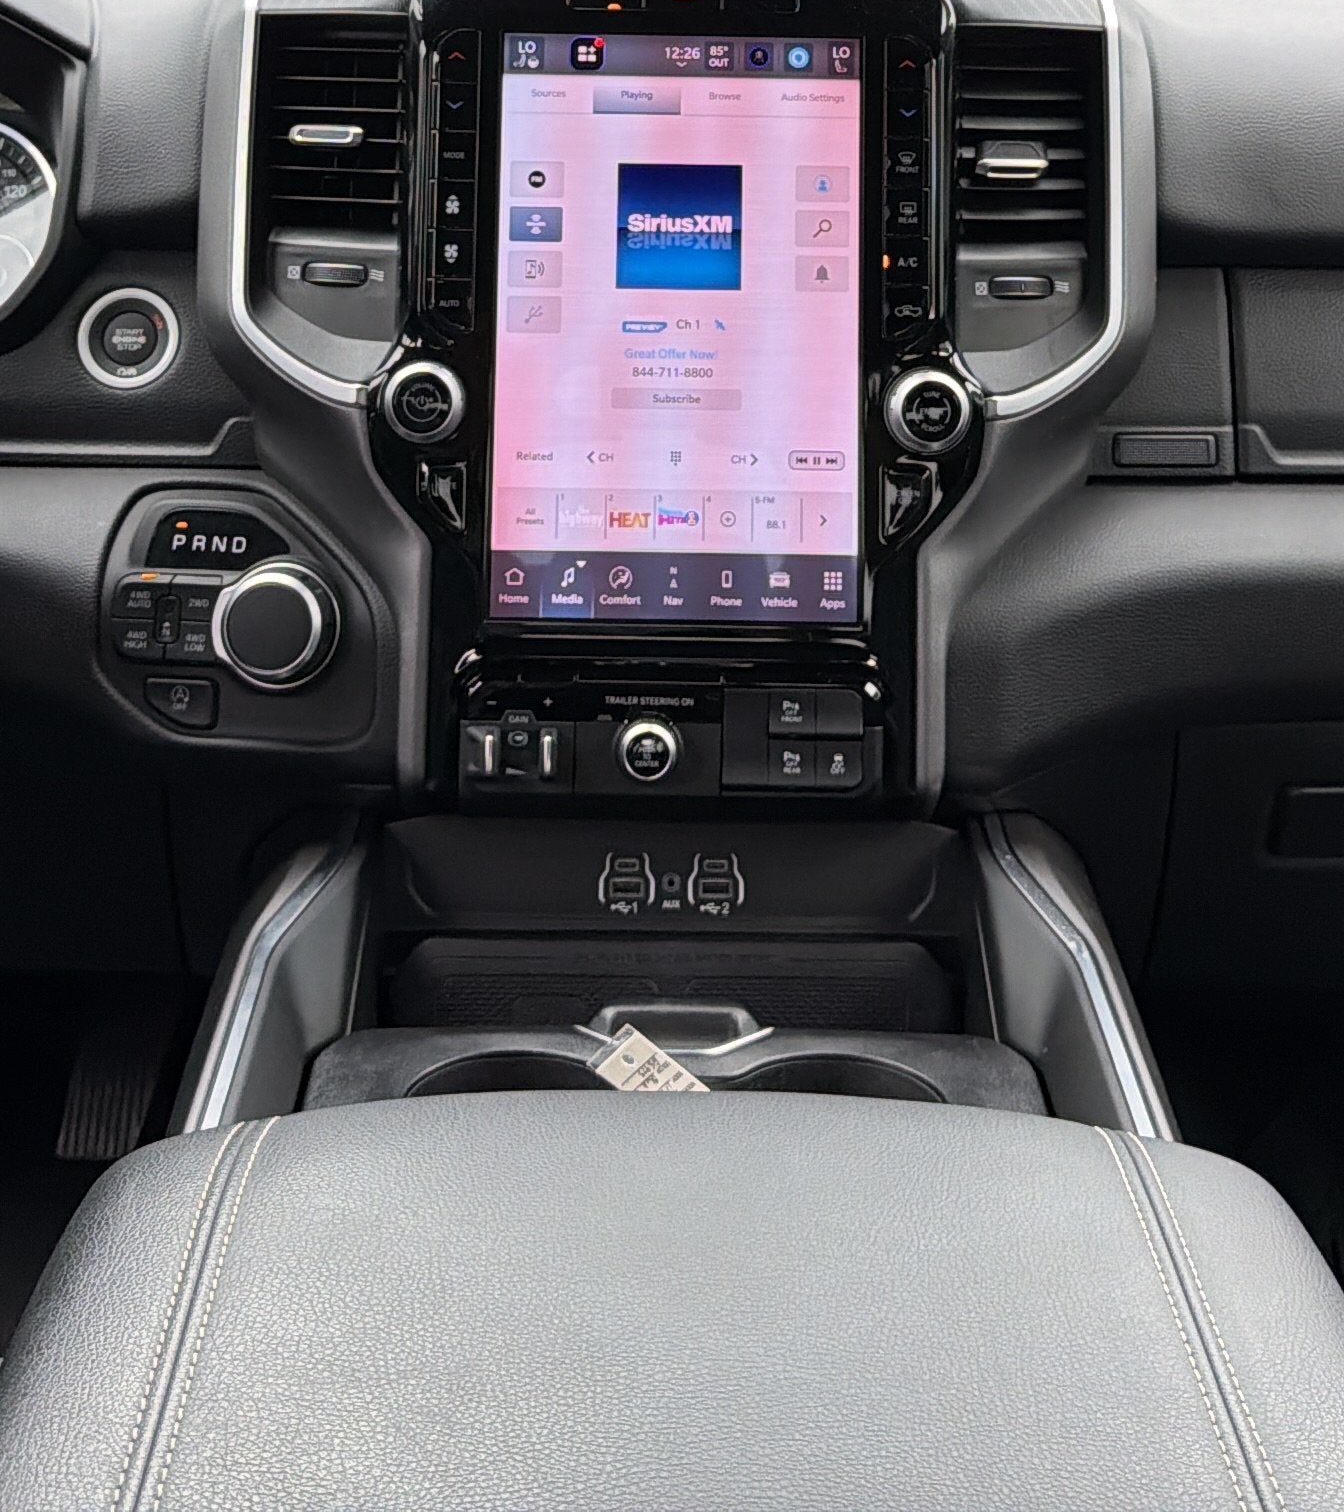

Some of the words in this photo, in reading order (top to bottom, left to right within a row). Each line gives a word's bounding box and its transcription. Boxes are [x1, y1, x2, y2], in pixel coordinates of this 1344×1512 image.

[517, 39, 537, 54] LO
[831, 45, 851, 59] LO
[664, 45, 701, 60] 12:26
[708, 58, 730, 68] OUT
[531, 88, 567, 98] Sources
[620, 90, 654, 102] Playing
[709, 91, 742, 101] Browse
[781, 93, 808, 102] Audio
[809, 93, 846, 104] Settings
[442, 151, 465, 159] MODE
[896, 165, 920, 174] FRONT
[2, 184, 28, 198] 120
[626, 213, 733, 233] SiriusXM
[897, 256, 919, 268] A/C
[438, 299, 461, 308] AUTO
[675, 319, 692, 330] Ch
[624, 347, 656, 359] Great
[658, 347, 687, 359] Offer
[632, 366, 714, 378] 844-711-8800
[652, 393, 702, 404] Subscribe
[516, 451, 554, 462] Related
[598, 453, 614, 463] CH
[730, 454, 747, 464] CH
[516, 517, 545, 526] Presets
[609, 511, 652, 529] HEAT
[188, 598, 210, 608] 2WD
[498, 592, 530, 605] Home
[551, 593, 584, 605] Media
[598, 594, 642, 606] Comfort
[663, 595, 684, 606] Nav
[709, 595, 743, 607] Phone
[760, 596, 799, 608] Vehicle
[819, 597, 847, 610] Apps
[127, 600, 152, 609] AUTO
[185, 633, 206, 643] 4WD
[123, 640, 148, 649] HIGH
[184, 642, 206, 652] LOW
[604, 695, 639, 705] TRAILER
[639, 696, 680, 706] STEERING
[681, 697, 695, 707] ON
[508, 714, 529, 724] GAIN
[661, 899, 681, 909] AUX
